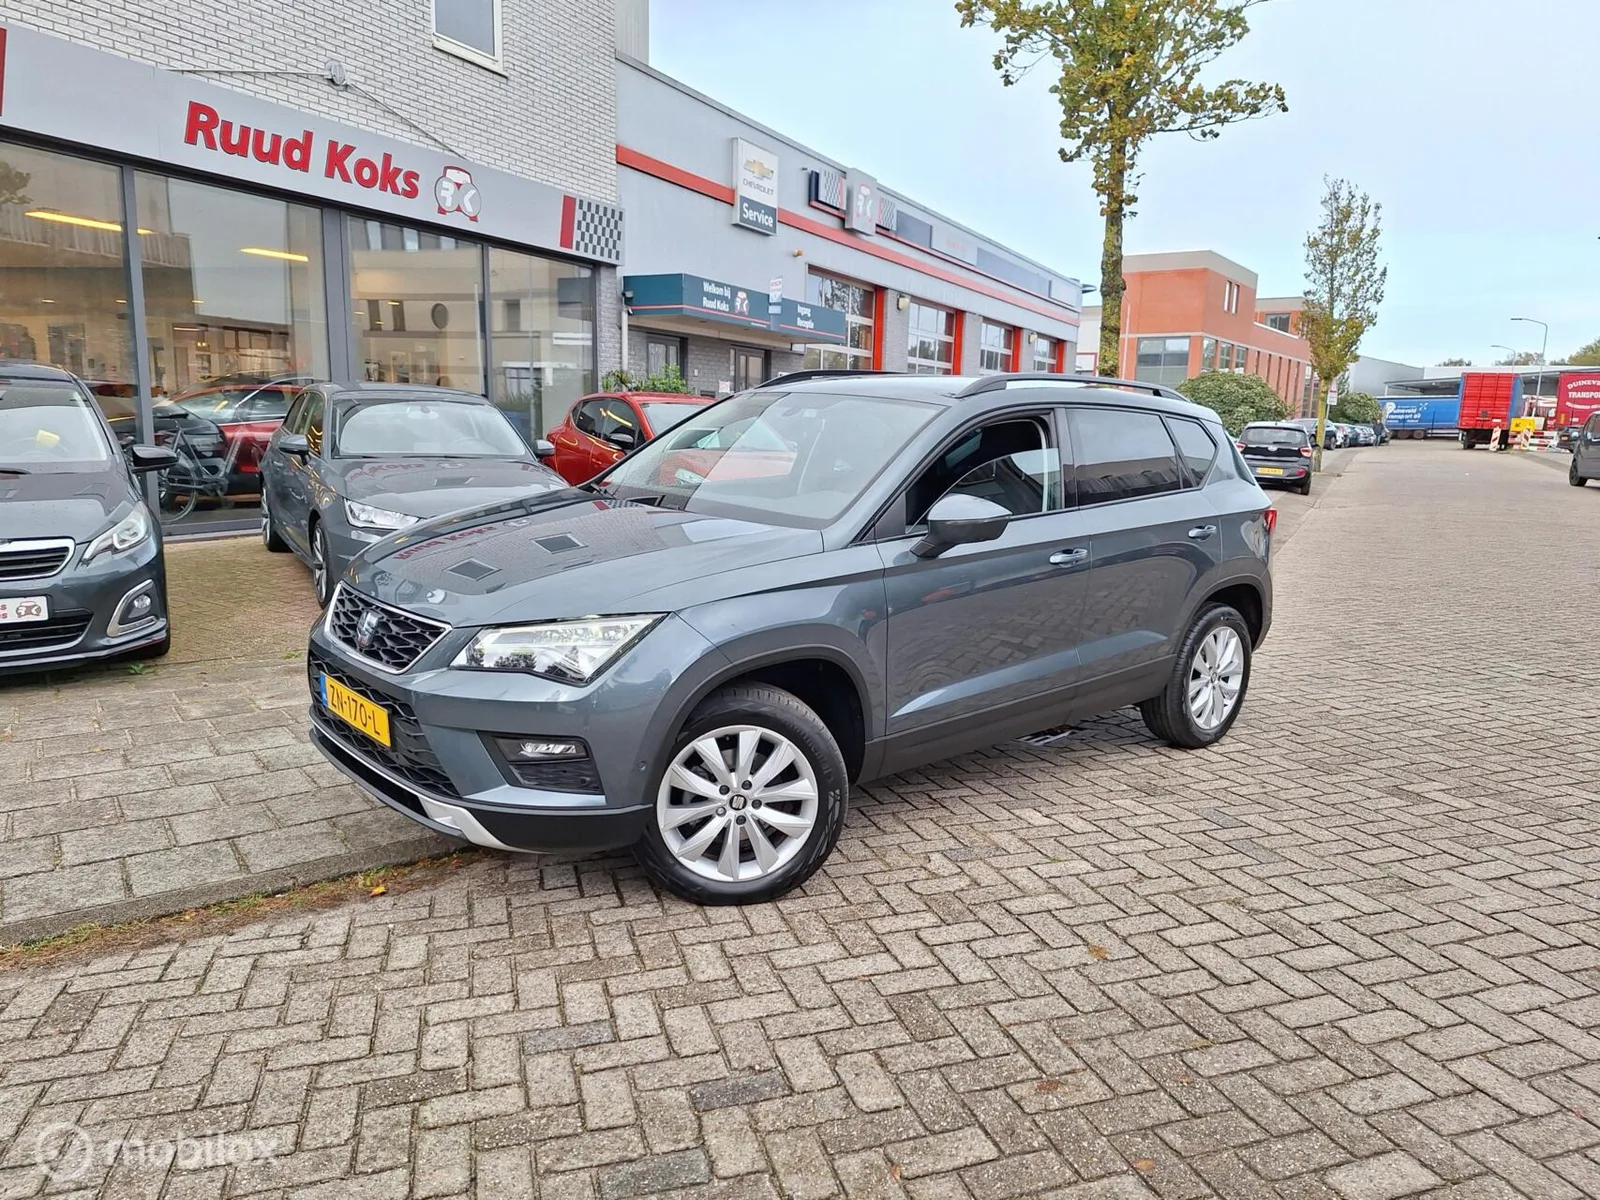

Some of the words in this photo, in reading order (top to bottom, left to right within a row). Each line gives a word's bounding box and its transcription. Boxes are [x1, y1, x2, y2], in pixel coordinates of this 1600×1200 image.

[184, 100, 314, 173] Ruud
[324, 139, 420, 199] Koks
[743, 178, 775, 196] CHEVROLET
[743, 202, 774, 228] Service
[703, 281, 724, 296] Welkom
[329, 684, 380, 736] ZN-170-L
